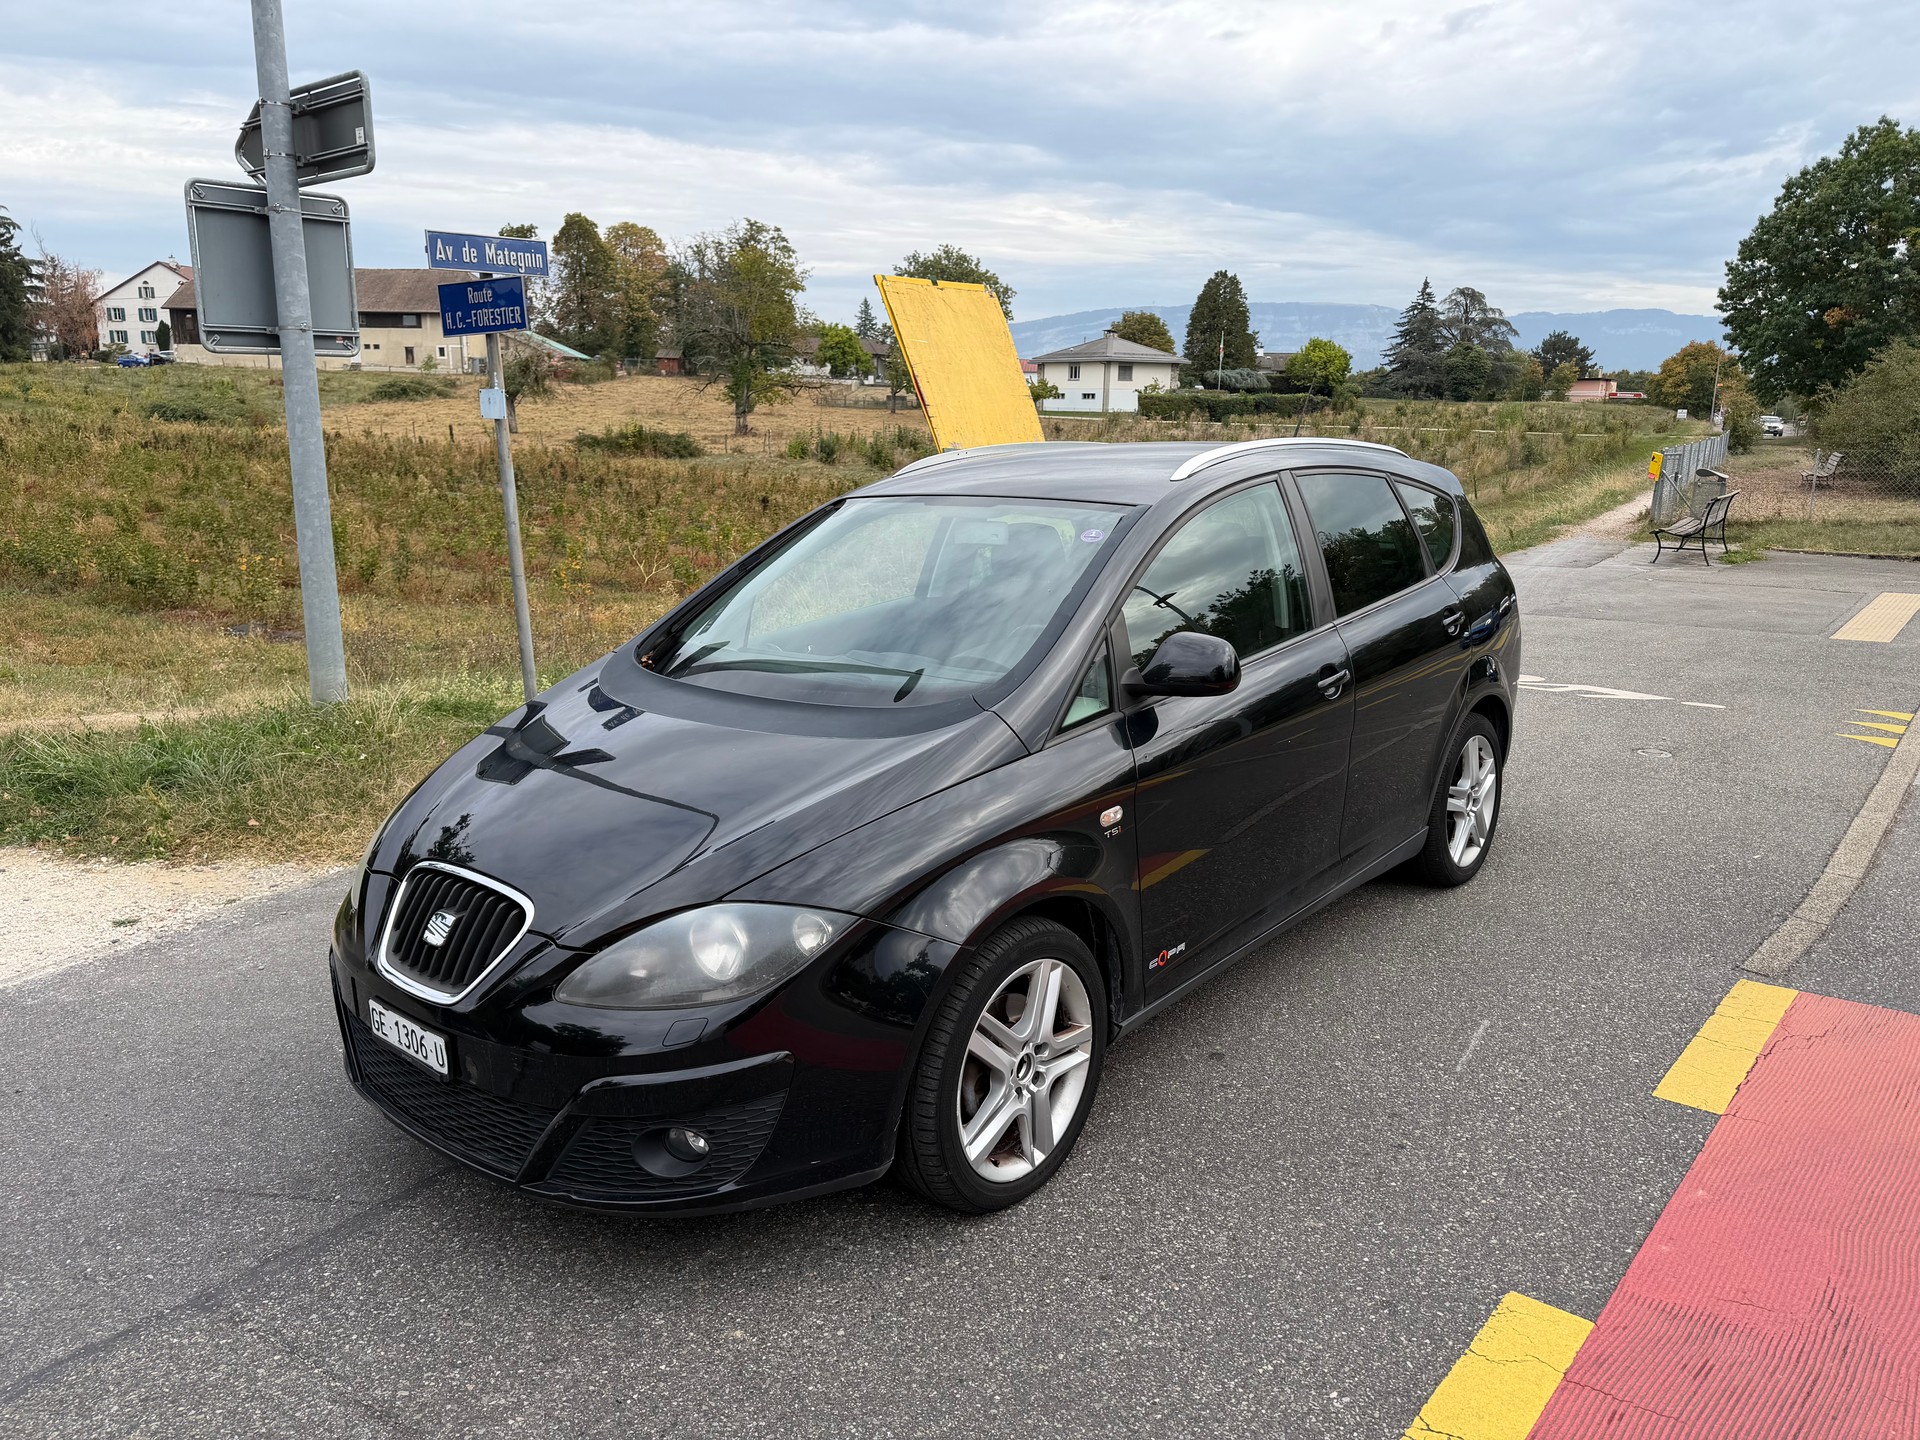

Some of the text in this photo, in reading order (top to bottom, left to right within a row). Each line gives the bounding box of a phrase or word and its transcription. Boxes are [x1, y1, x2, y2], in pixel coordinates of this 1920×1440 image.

[436, 238, 543, 273] Av. de Mategnin
[467, 287, 493, 304] Route
[1148, 942, 1186, 970] COPA
